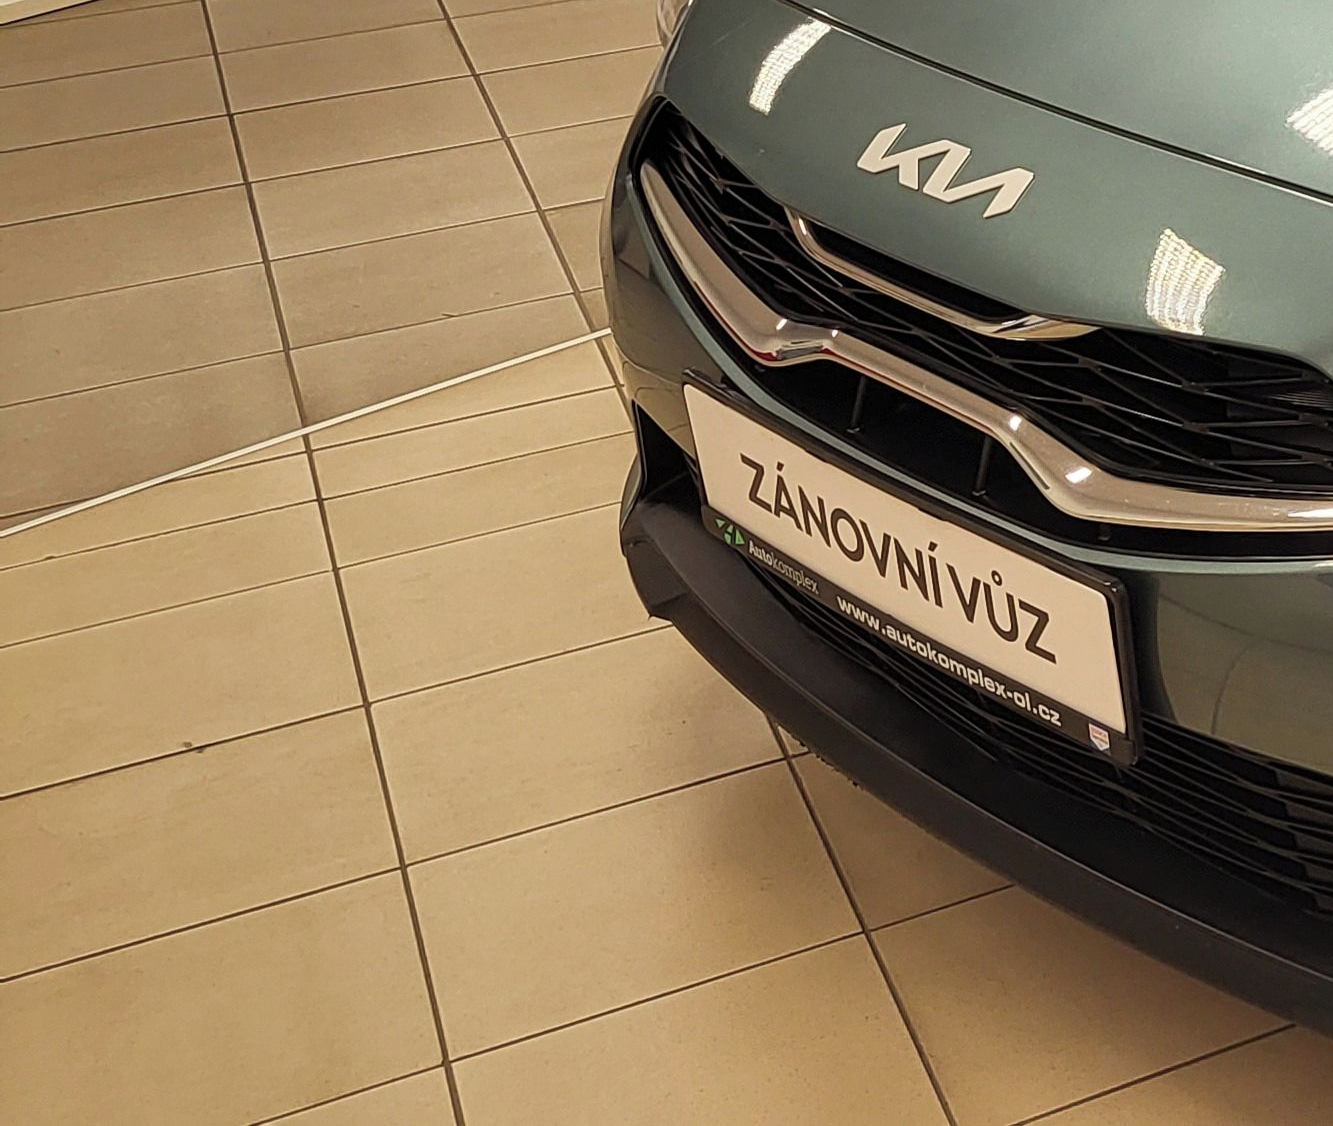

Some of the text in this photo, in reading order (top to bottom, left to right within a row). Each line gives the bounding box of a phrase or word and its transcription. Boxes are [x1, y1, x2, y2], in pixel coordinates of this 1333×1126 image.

[856, 122, 1036, 219] KIA
[739, 452, 1057, 665] ZÁNOVNÍ VŮZ
[749, 539, 820, 595] Autokomplex
[836, 595, 1063, 728] www.autokomplex-ol.cz
